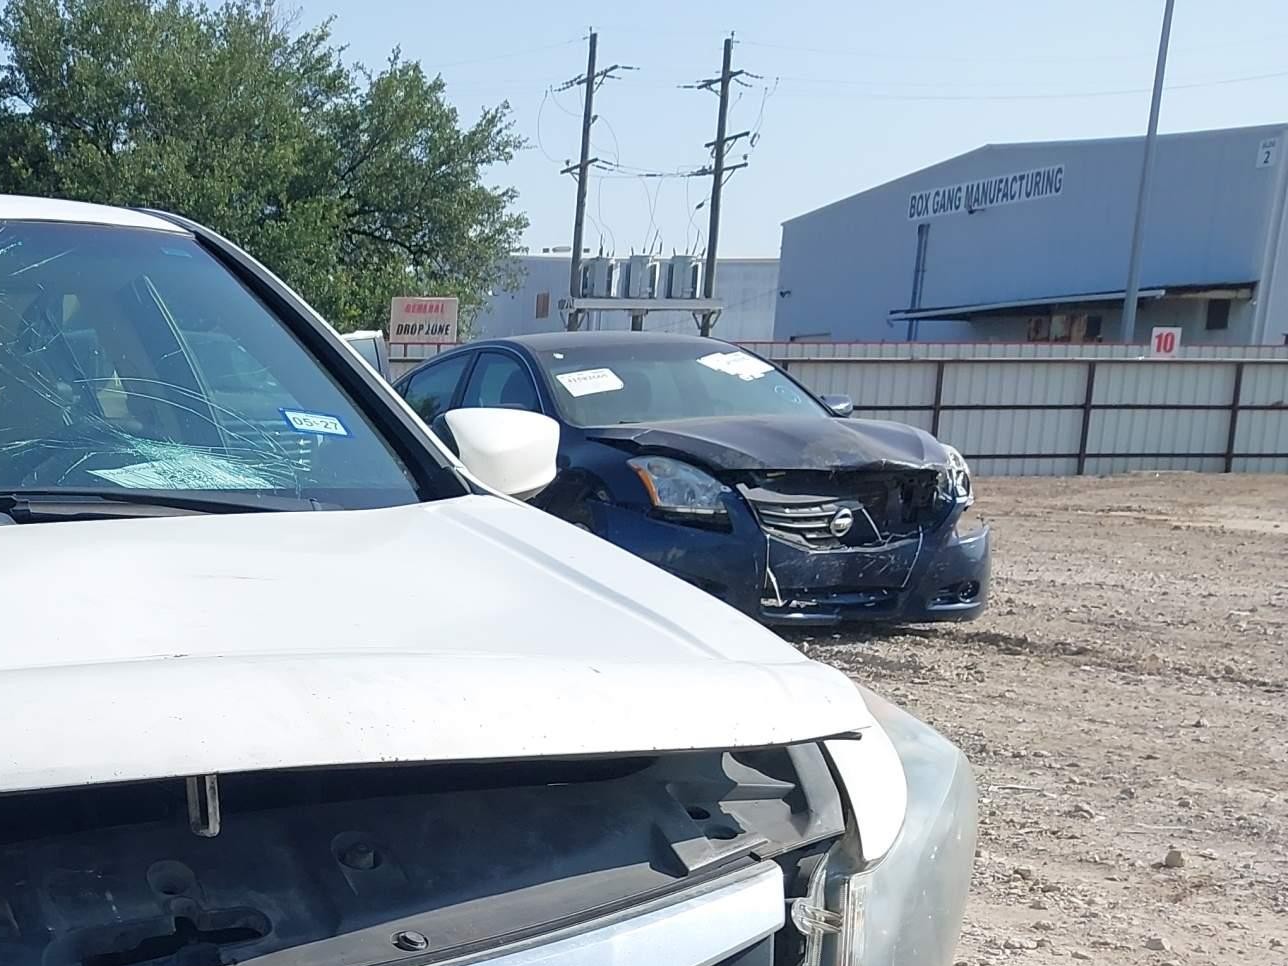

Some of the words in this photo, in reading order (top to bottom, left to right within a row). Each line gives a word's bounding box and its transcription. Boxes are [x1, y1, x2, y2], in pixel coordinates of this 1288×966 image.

[909, 192, 931, 218] BOX
[932, 186, 962, 215] GANG
[964, 167, 1063, 209] MANUFACTURING
[396, 323, 424, 335] DROP
[425, 322, 451, 335] ZONE
[1155, 332, 1175, 353] 10
